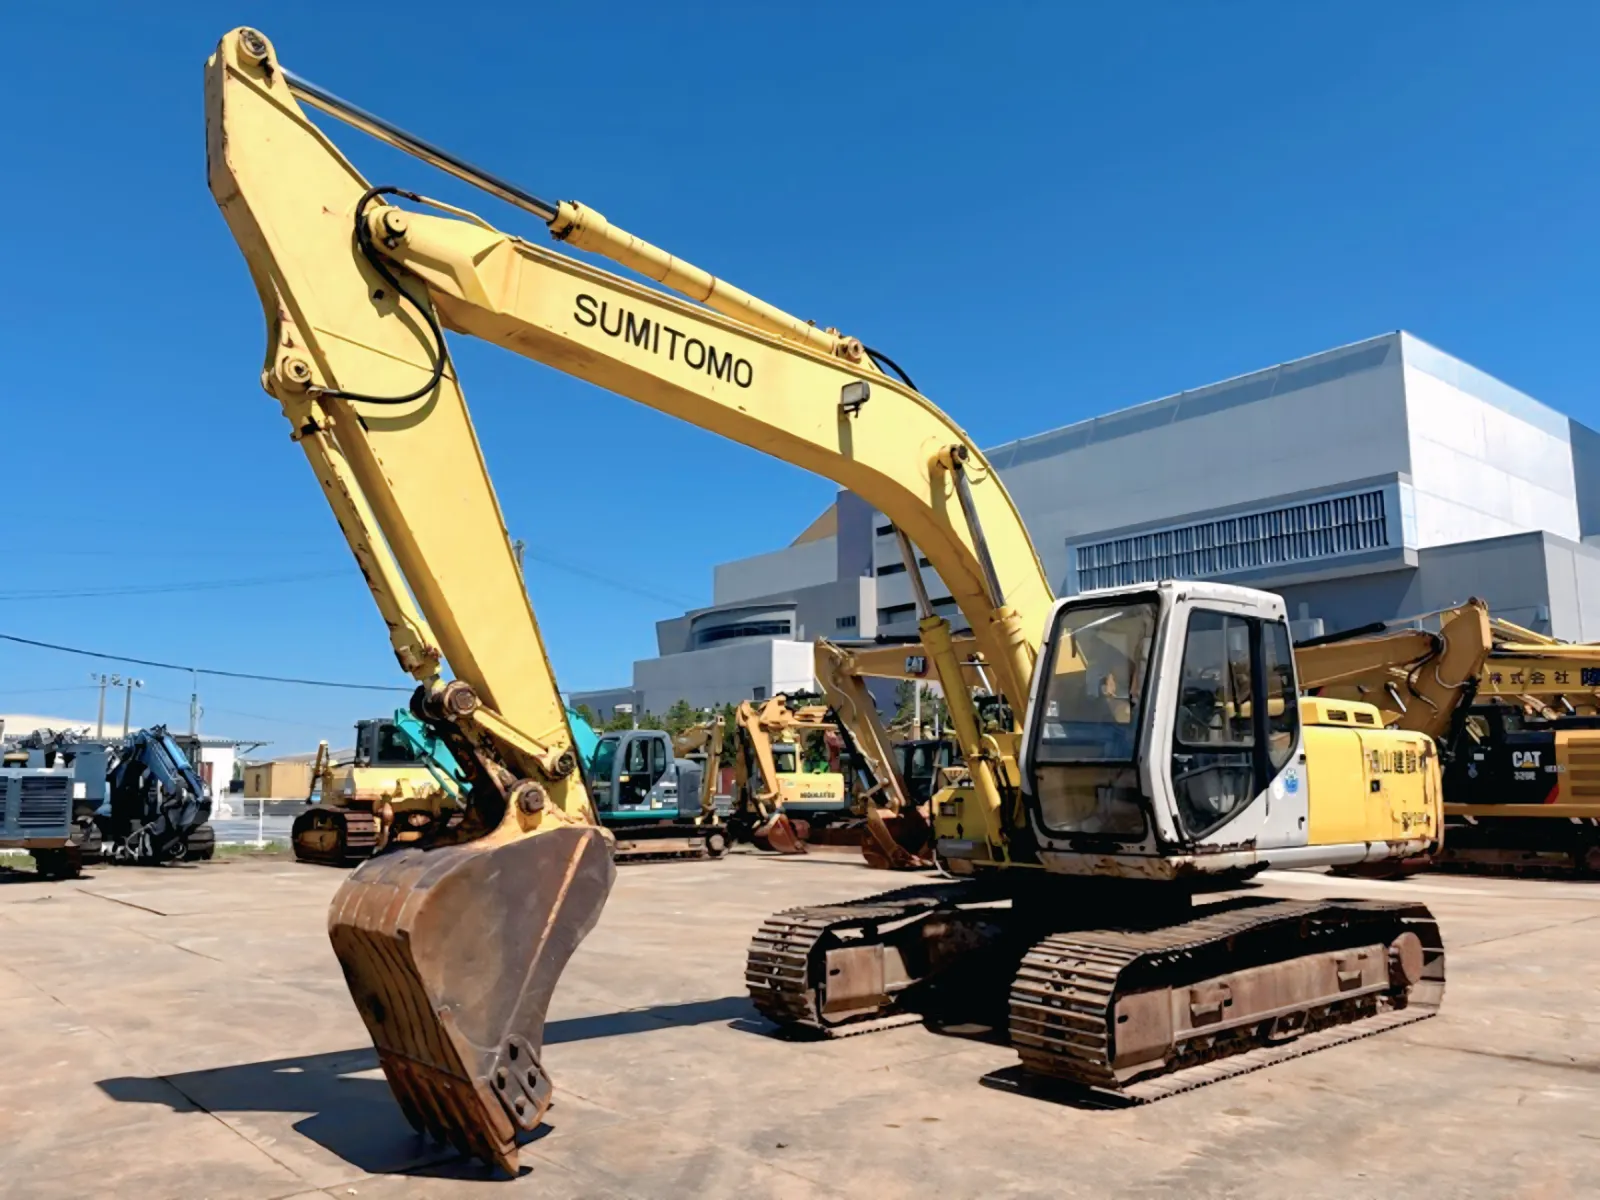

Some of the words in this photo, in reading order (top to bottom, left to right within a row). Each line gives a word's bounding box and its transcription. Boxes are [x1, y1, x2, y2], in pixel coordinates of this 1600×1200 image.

[573, 293, 754, 389] SUMITOMO
[905, 656, 925, 673] CAT
[1489, 670, 1570, 685] 株式会社
[1512, 751, 1542, 768] CAT
